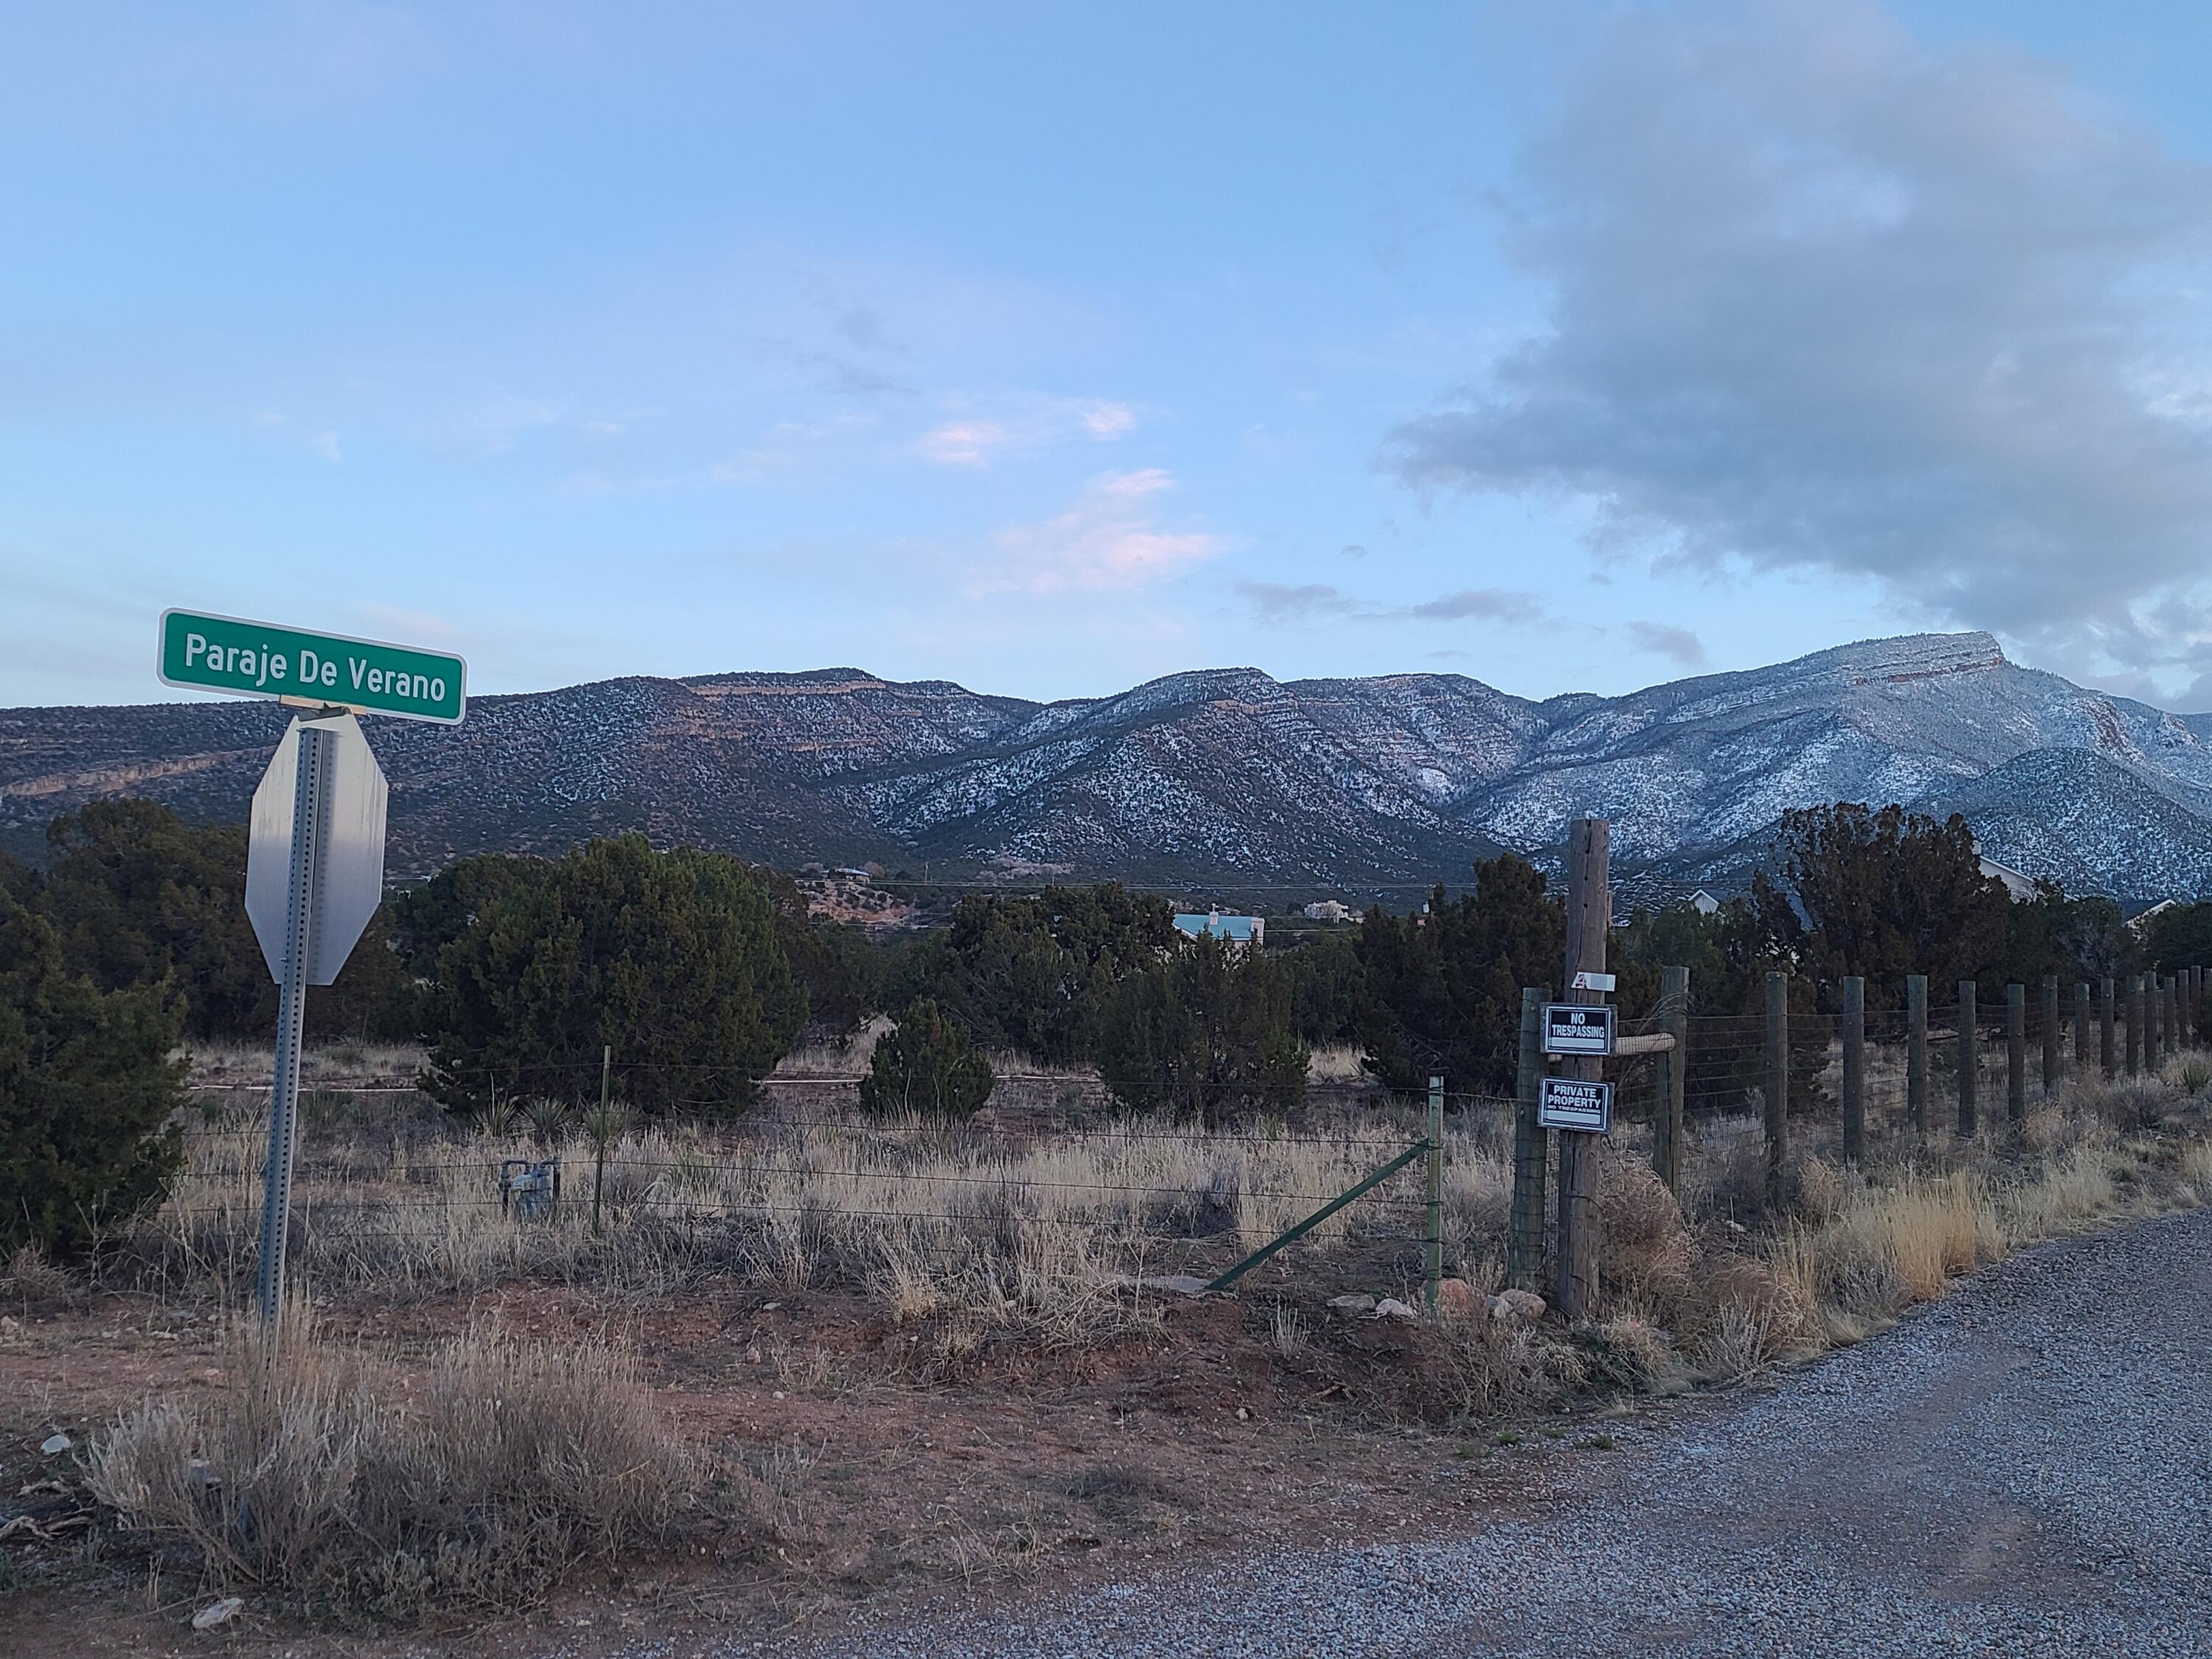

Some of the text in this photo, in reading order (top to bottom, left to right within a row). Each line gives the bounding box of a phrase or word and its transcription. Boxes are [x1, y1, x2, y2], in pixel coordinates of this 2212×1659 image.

[186, 633, 445, 701] Paraje De Verano
[1571, 1012, 1586, 1025] NO
[1551, 1024, 1605, 1038] TRESPASSING
[1554, 1085, 1597, 1098] PRIVATE
[1548, 1094, 1601, 1108] PROPERTY
[1558, 1105, 1601, 1114] TRESPASSING
